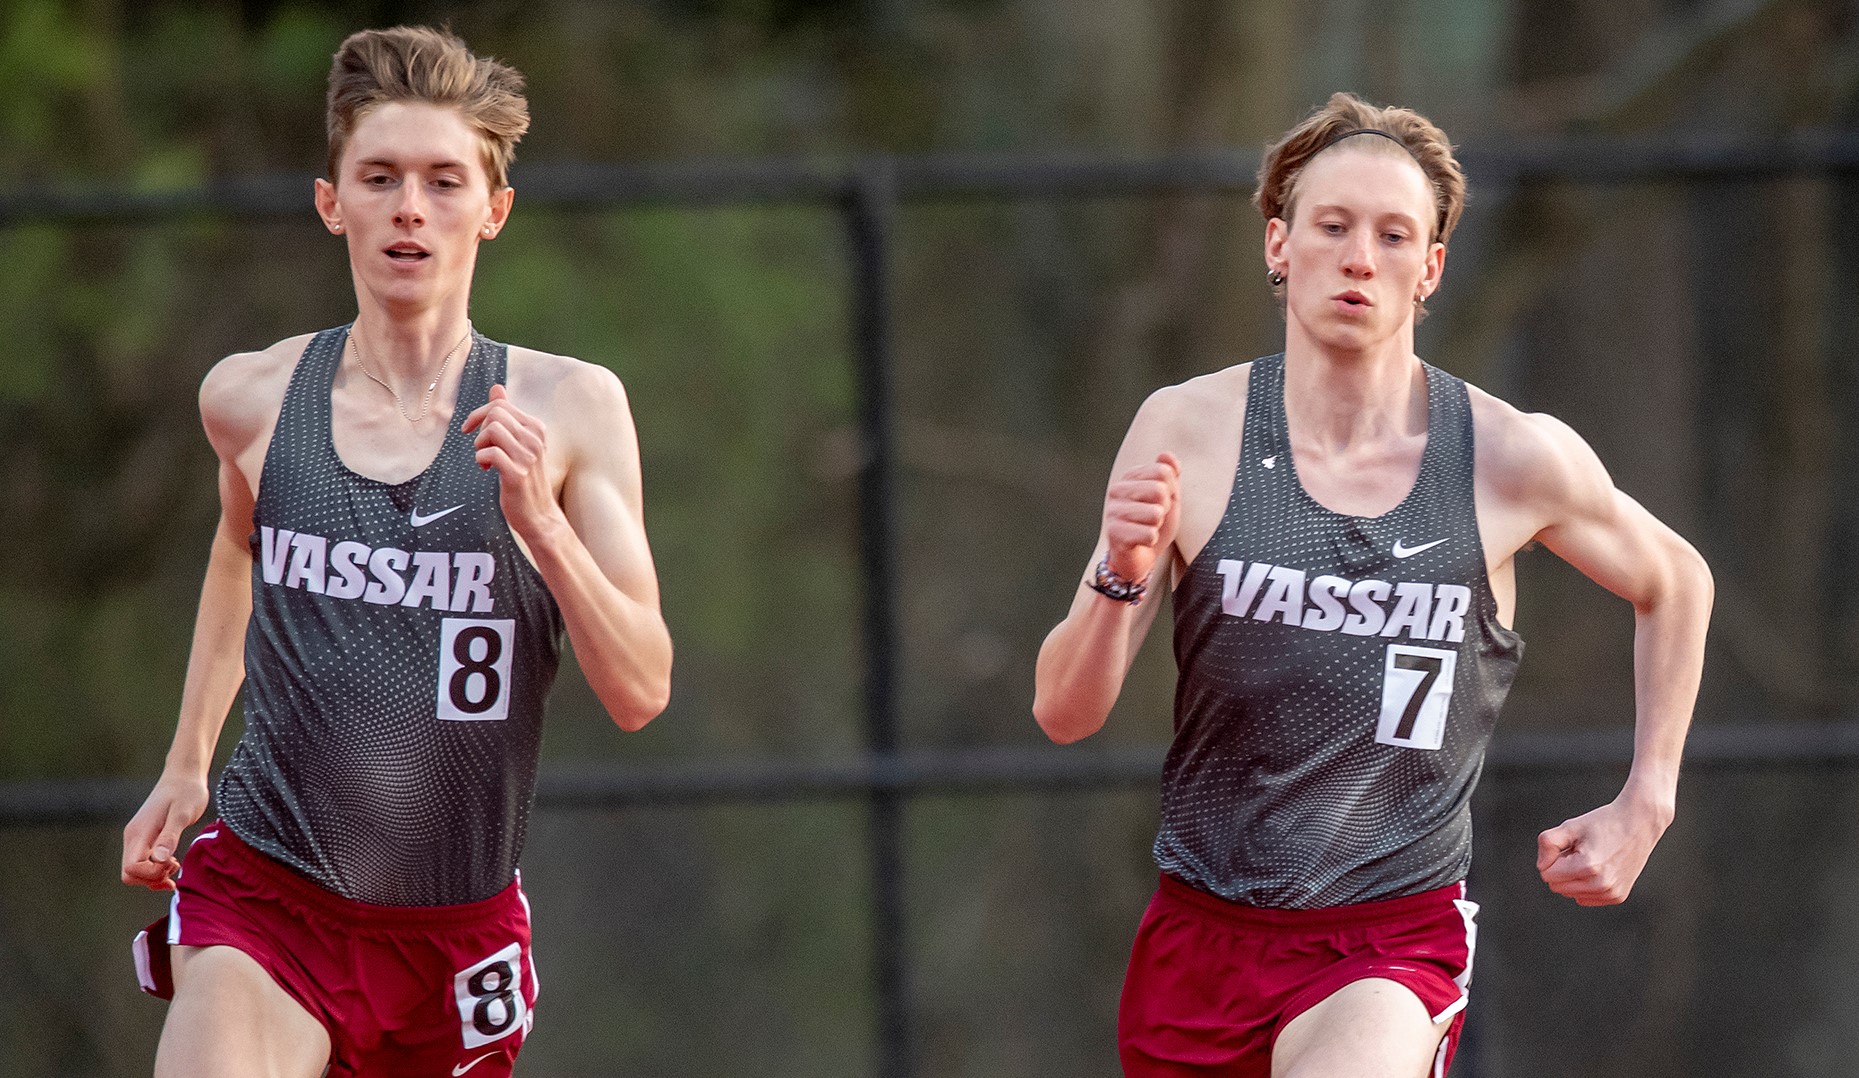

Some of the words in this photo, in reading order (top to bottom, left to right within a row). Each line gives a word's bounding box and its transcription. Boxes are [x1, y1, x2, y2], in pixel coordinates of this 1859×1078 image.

[260, 526, 495, 612] VASSAR
[1216, 559, 1472, 642] VASSAR
[449, 626, 502, 714] 8
[1393, 653, 1443, 740] 7
[468, 960, 516, 1036] 8
